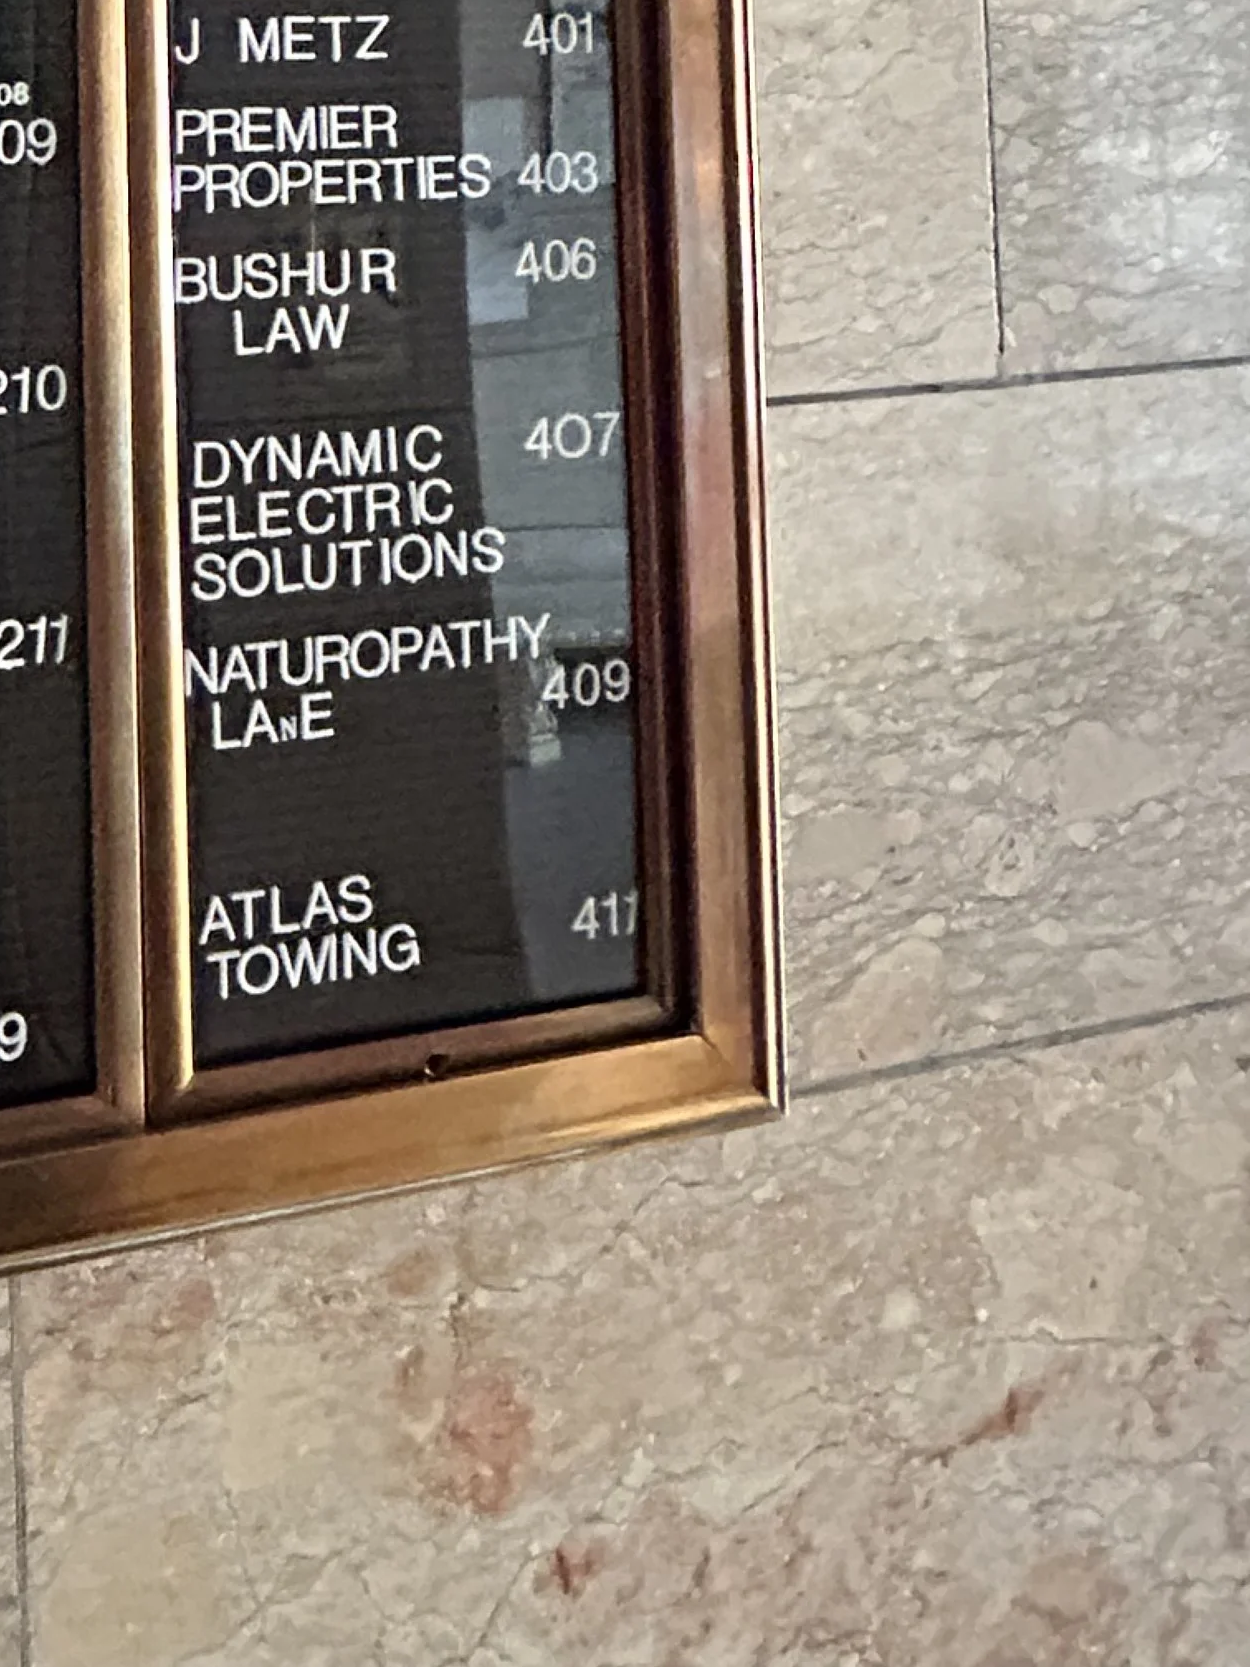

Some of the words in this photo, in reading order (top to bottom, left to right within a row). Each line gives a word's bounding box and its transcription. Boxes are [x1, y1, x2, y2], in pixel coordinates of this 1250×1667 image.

[175, 17, 200, 64] J
[238, 14, 389, 62] METZ
[522, 12, 593, 55] 401
[175, 105, 397, 157] PREMIER
[173, 154, 491, 213] PROPERTIES
[517, 151, 598, 195] 403
[174, 248, 397, 303] BUSHUR
[515, 238, 596, 285] 406
[233, 304, 349, 356] LAW
[192, 425, 442, 489] DYNAMIC
[524, 411, 620, 459] 407
[190, 477, 453, 545] ELECTRIC
[191, 527, 505, 601] SOLUTIONS
[184, 613, 550, 697] NATUROPATHY
[542, 659, 631, 709] 409
[199, 874, 373, 945] ATLAS
[571, 890, 638, 939] 411
[206, 923, 420, 1000] TOWING
